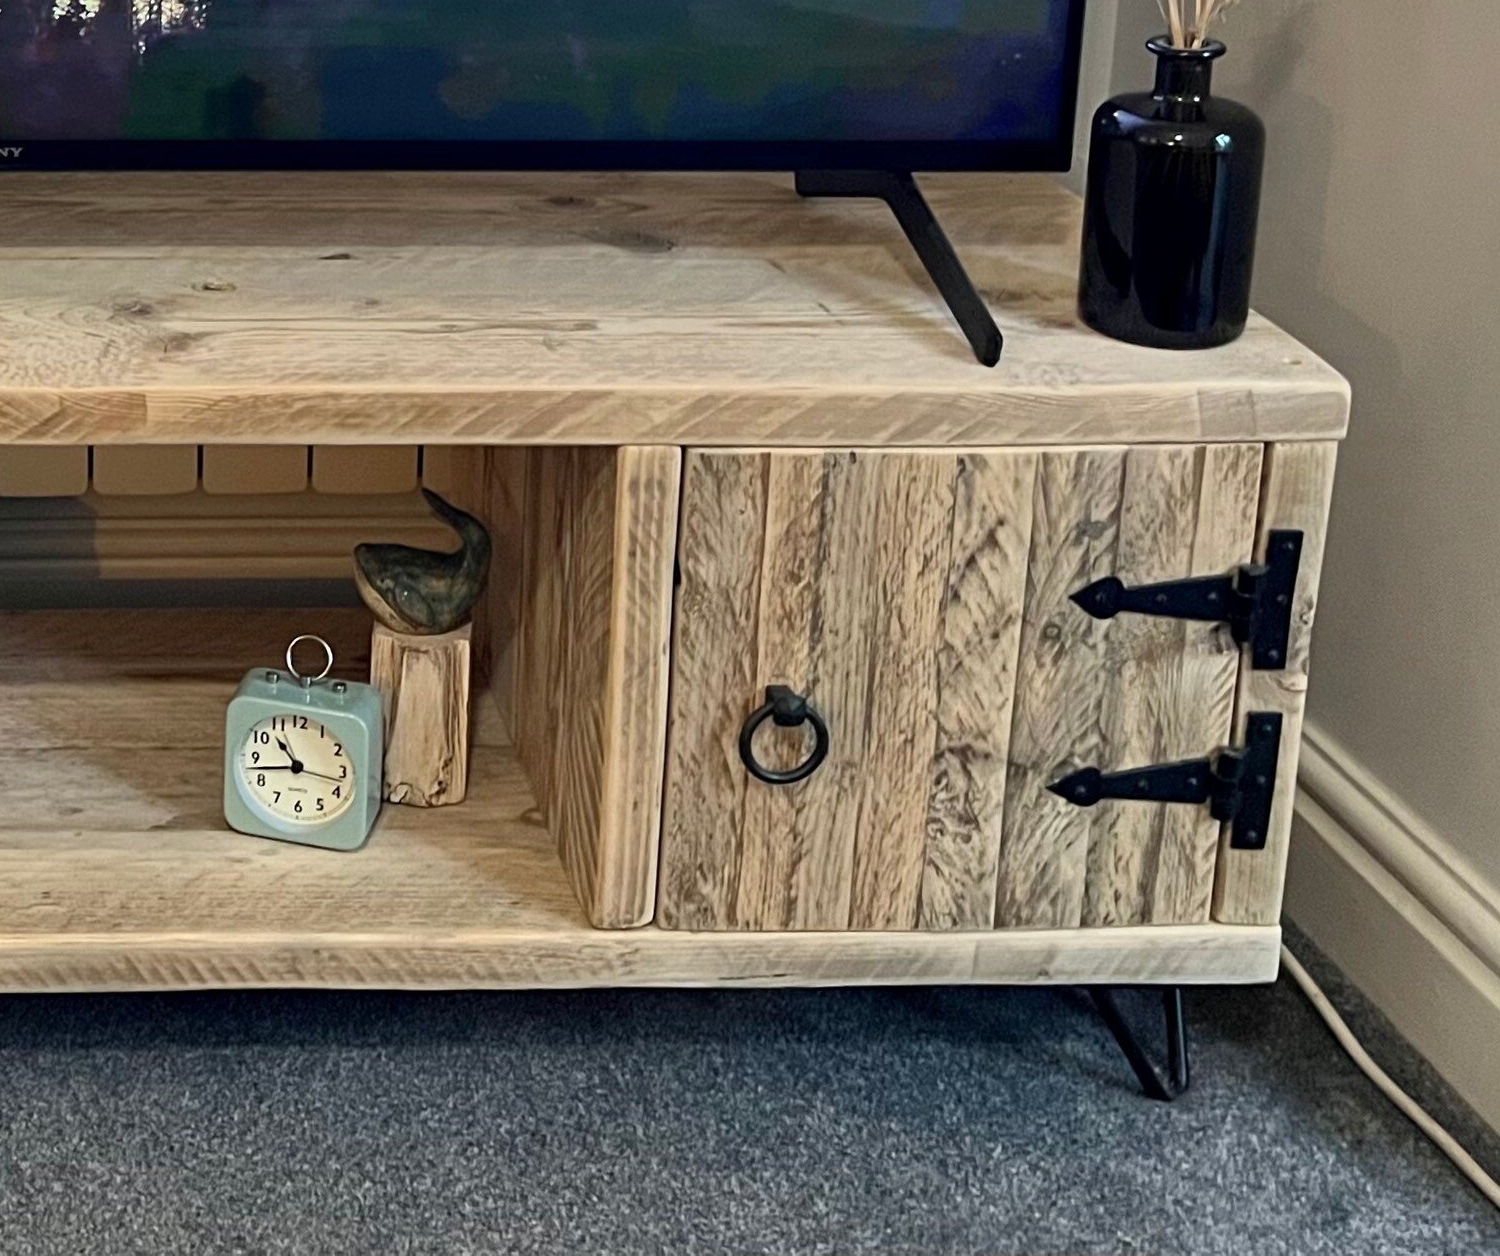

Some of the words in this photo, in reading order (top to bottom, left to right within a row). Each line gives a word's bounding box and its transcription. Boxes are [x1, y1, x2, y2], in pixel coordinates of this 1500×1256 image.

[272, 717, 285, 731] 11
[293, 715, 308, 729] 12
[254, 730, 269, 744] 10
[320, 724, 324, 738] 1
[333, 743, 342, 756] 2
[251, 751, 260, 764] 9
[338, 765, 347, 778] 3
[257, 773, 266, 787] 8
[273, 791, 281, 803] 7
[331, 785, 340, 799] 4
[294, 800, 303, 813] 6
[316, 798, 324, 811] 5
